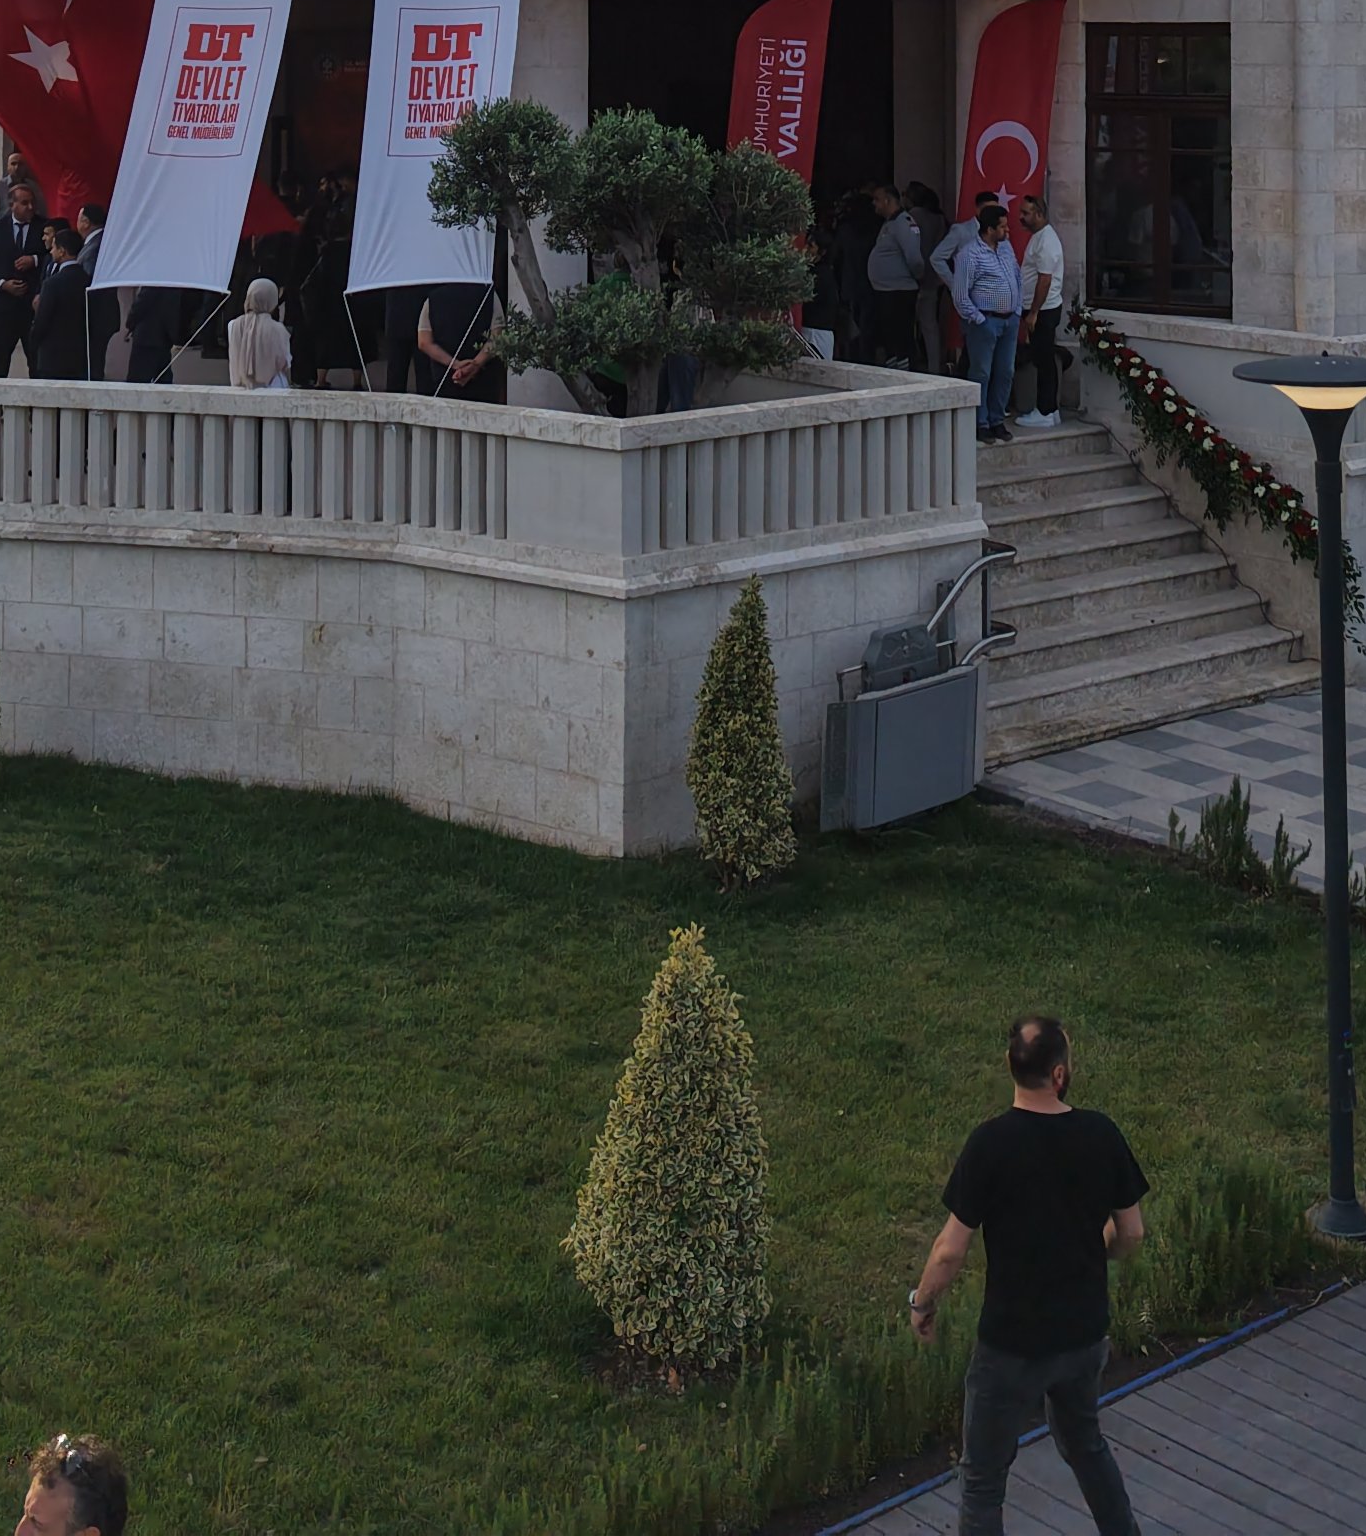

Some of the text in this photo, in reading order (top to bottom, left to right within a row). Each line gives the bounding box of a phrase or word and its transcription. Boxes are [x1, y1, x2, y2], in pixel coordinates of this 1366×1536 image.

[183, 23, 255, 61] DT
[411, 23, 483, 61] DT
[175, 65, 247, 100] DEVLET
[408, 64, 478, 100] DEVLET
[753, 37, 777, 155] UMHURİYETİ
[777, 39, 808, 158] VALİLİĞİ
[167, 125, 190, 139] GENEL
[405, 126, 427, 139] GENEL
